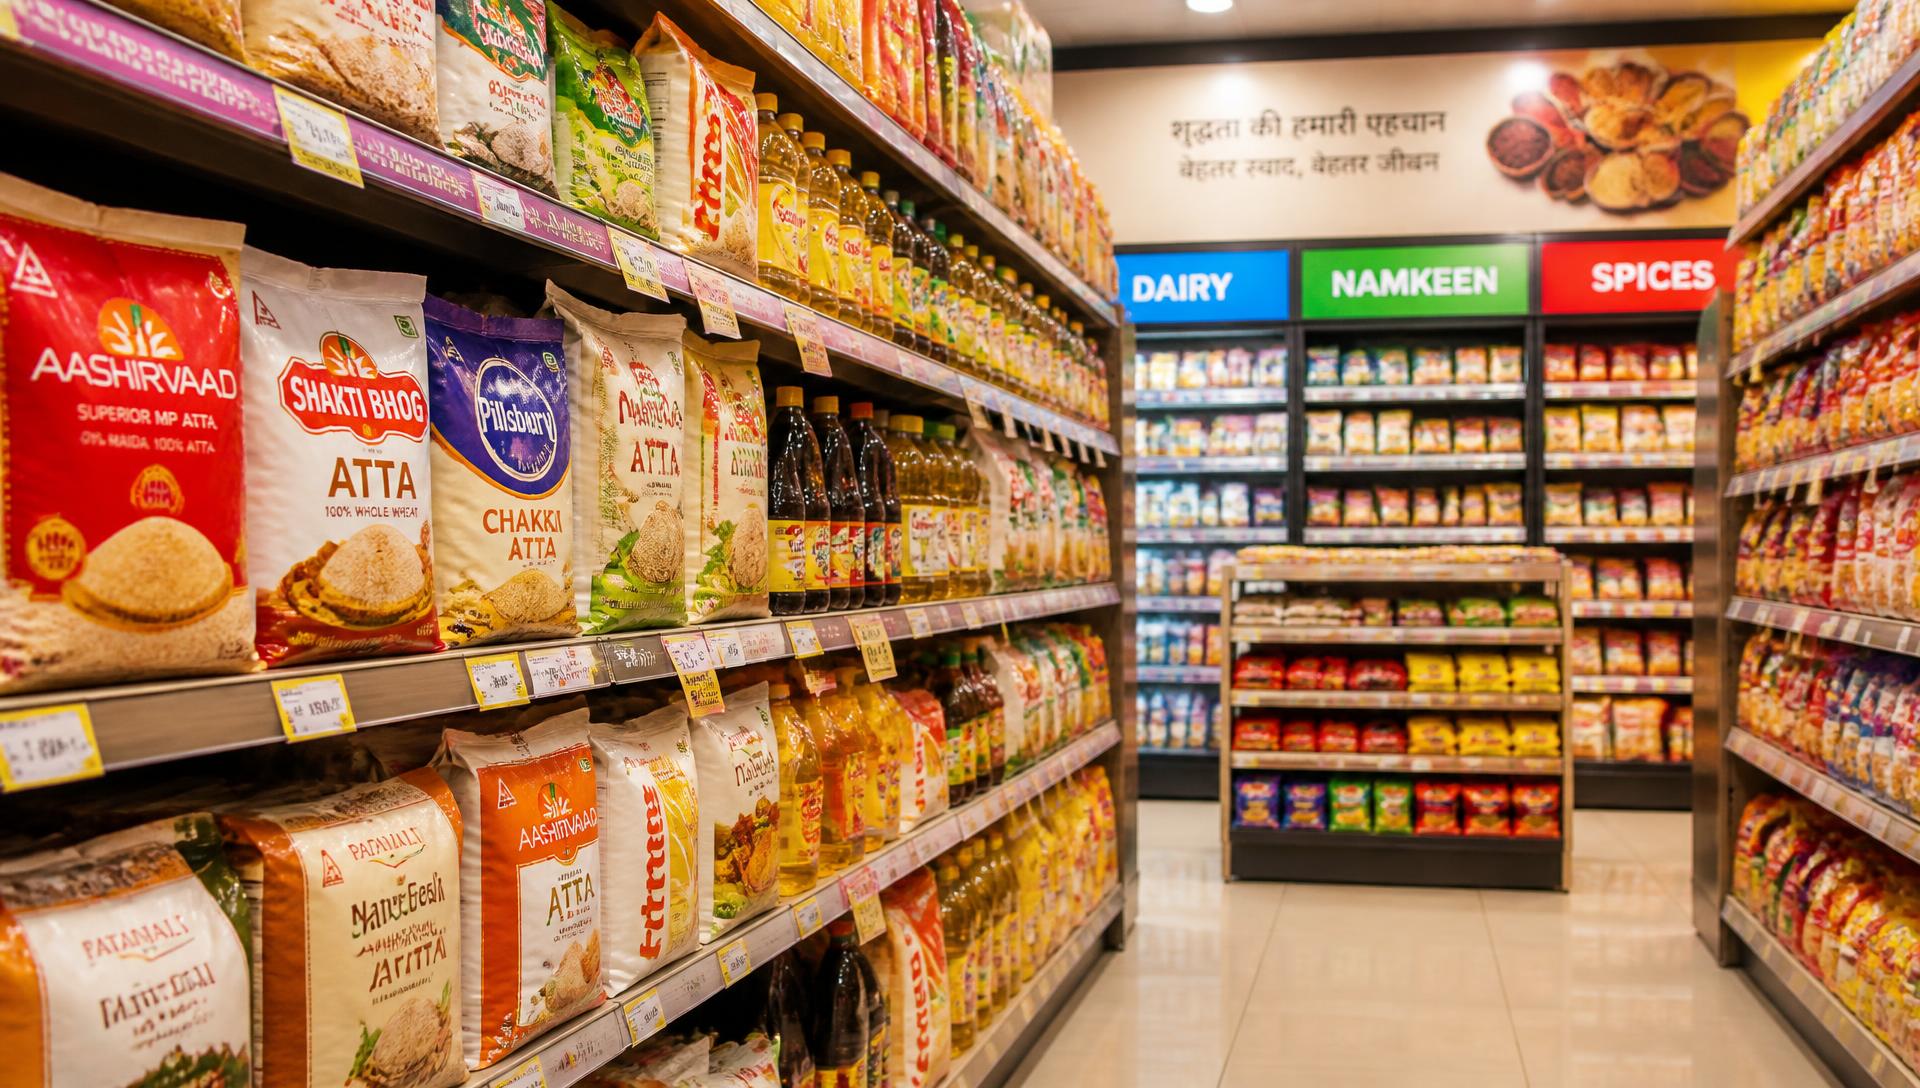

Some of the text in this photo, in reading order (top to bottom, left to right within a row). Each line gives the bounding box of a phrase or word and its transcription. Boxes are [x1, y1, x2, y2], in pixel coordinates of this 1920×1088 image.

[1249, 108, 1281, 137] की
[1292, 107, 1356, 139] हमारी
[1376, 146, 1440, 173] जीवन
[1132, 272, 1233, 303] DAIRY
[1331, 266, 1498, 298] NAMKEEN
[1591, 260, 1716, 292] SPICES
[30, 347, 237, 399] AASHIRVAAD
[289, 375, 424, 422] SHAKTI BHOG
[77, 403, 218, 431] SUPERIOR MP ATTA
[478, 397, 556, 443] Pillsbury
[186, 439, 216, 454] ATTA
[328, 457, 417, 499] ATTA
[325, 506, 352, 518] 100%
[355, 506, 389, 518] WHOLE
[482, 508, 563, 534] CHAKKI
[508, 537, 557, 561] ATTA
[546, 873, 595, 926] ATTA
